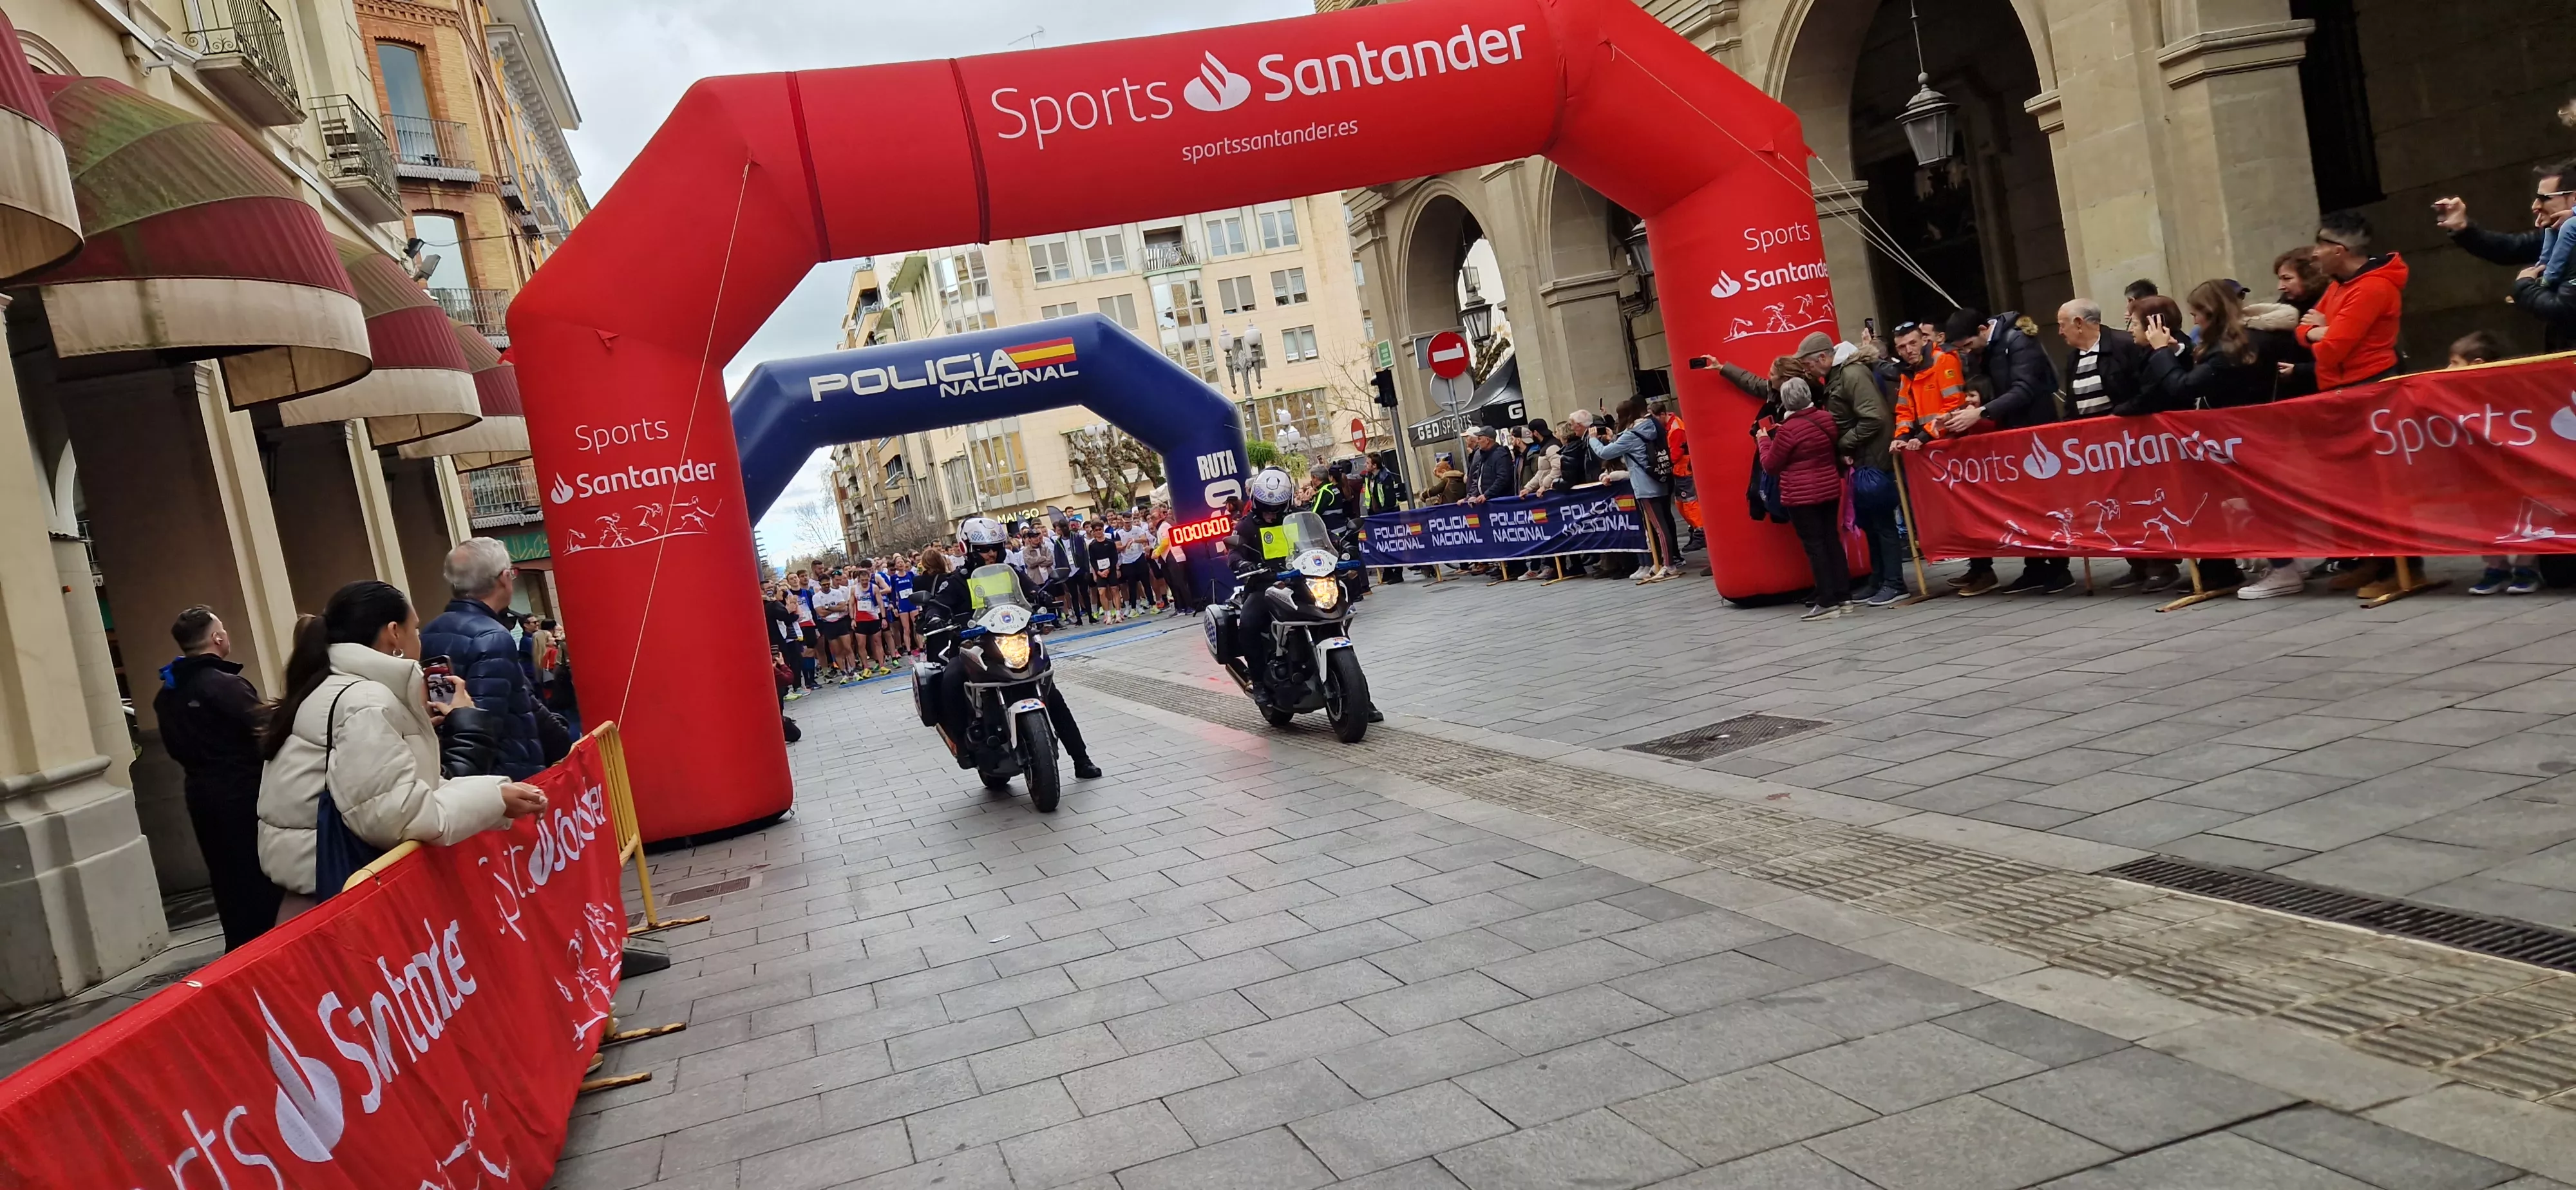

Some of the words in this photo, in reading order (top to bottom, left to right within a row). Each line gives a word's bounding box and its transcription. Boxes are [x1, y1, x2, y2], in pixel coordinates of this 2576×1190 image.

[990, 75, 1173, 149] Sports
[1258, 23, 1527, 103] Santander
[1182, 117, 1359, 164] sportssantander.es
[1743, 222, 1811, 253] Sports
[1743, 258, 1828, 292] Santande
[939, 363, 1079, 399] NACIONAL
[574, 418, 669, 455] Sports
[2370, 403, 2537, 466] Sports
[576, 458, 717, 498] Santander
[1197, 449, 1238, 481] RUTA
[1929, 449, 2020, 491] Sports
[2062, 430, 2242, 475] Santander
[1432, 529, 1483, 547] NACIONAL
[1492, 525, 1551, 543] NACIONAL
[1562, 514, 1640, 536] NACIONAL
[1376, 536, 1425, 553] NACIONAL
